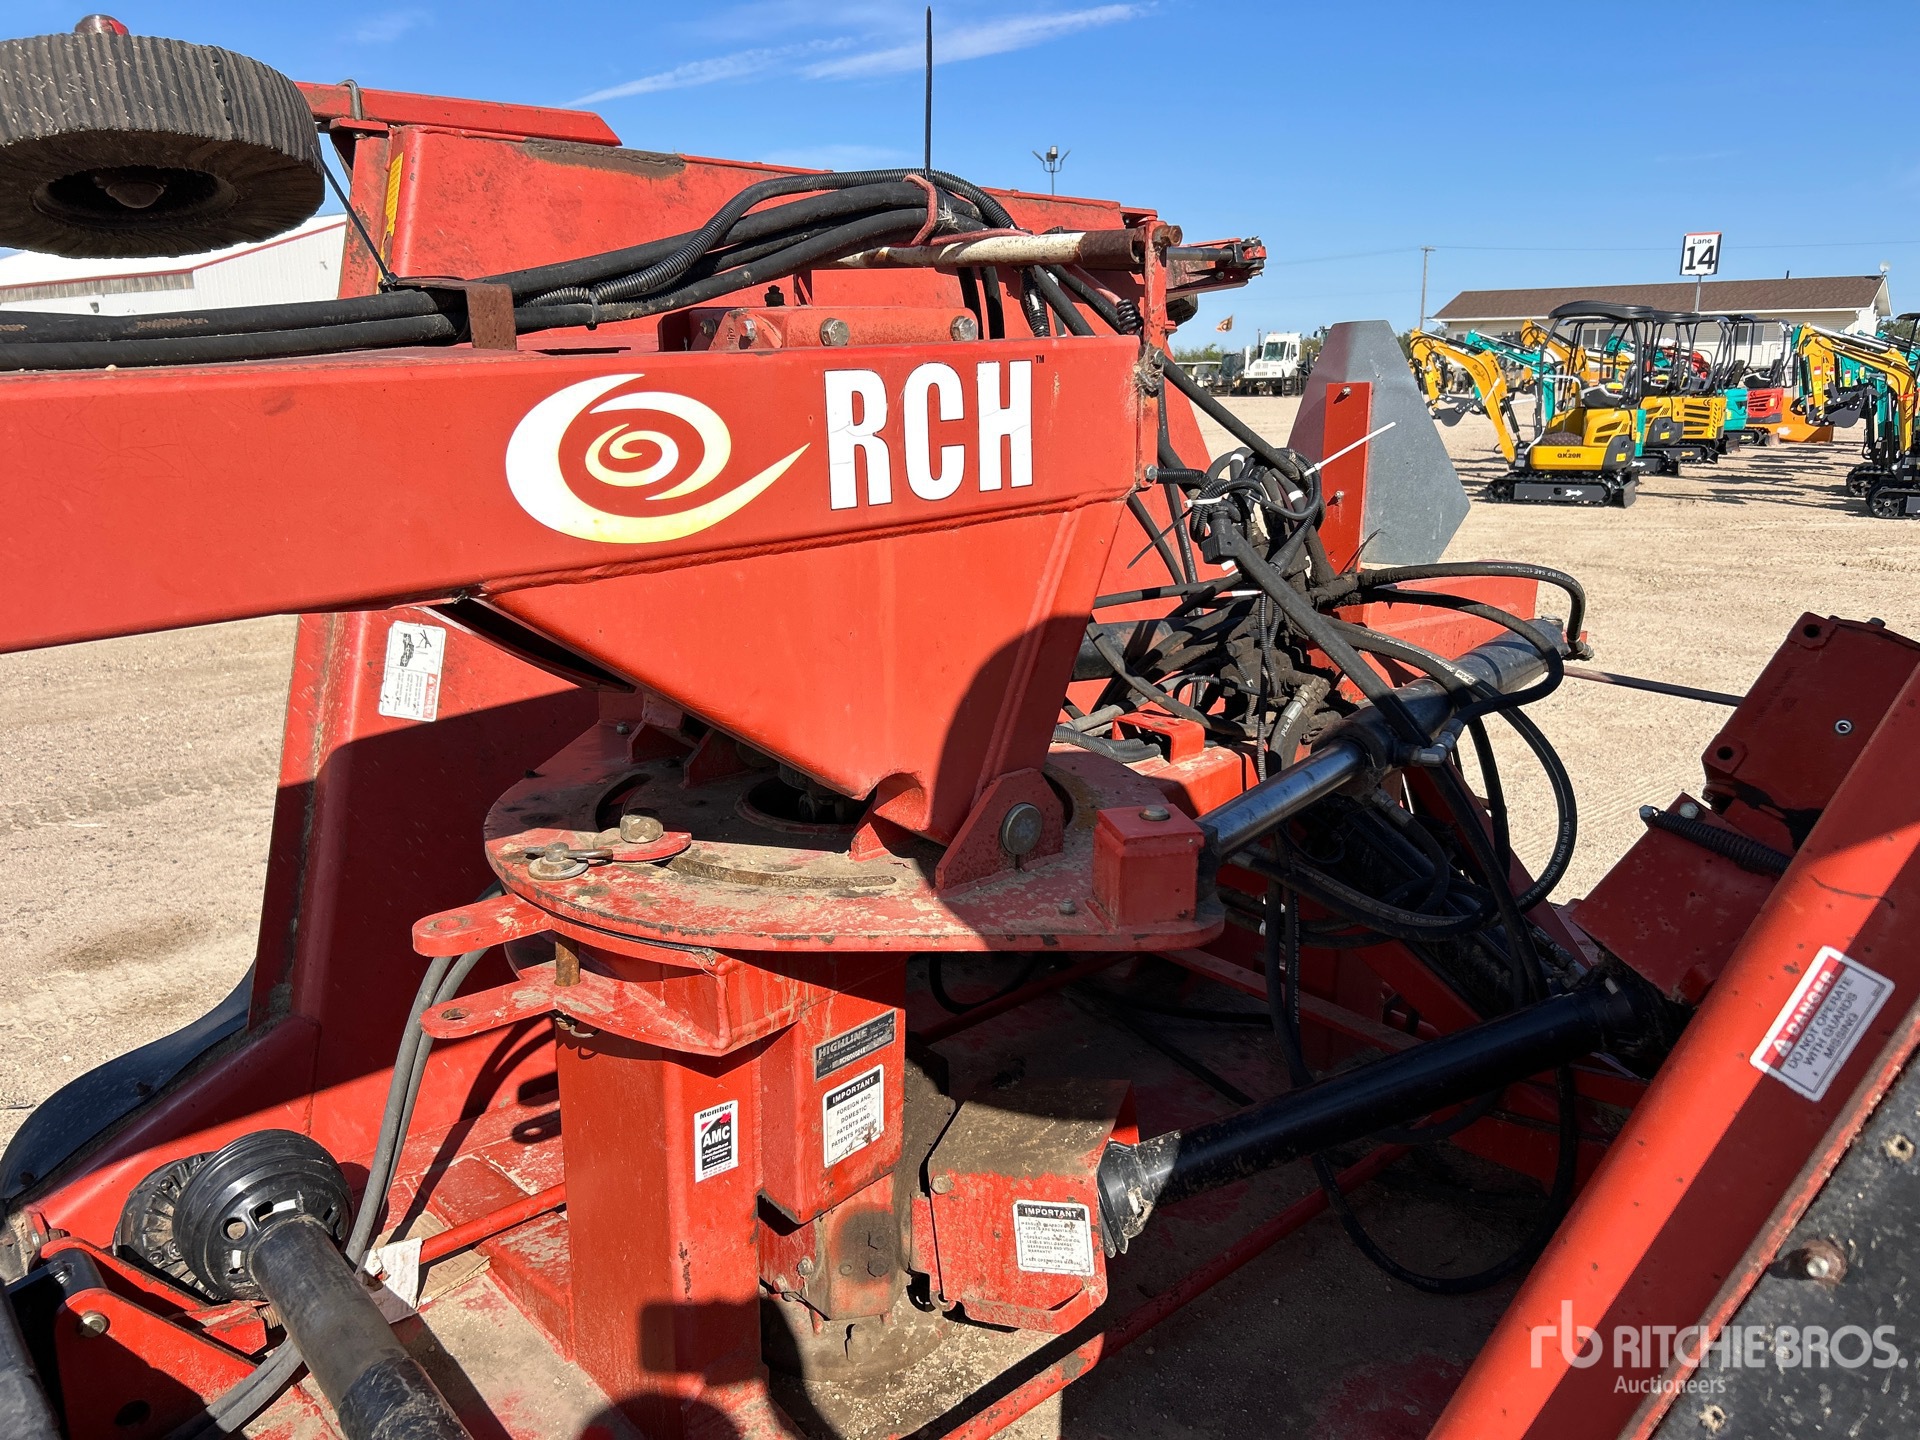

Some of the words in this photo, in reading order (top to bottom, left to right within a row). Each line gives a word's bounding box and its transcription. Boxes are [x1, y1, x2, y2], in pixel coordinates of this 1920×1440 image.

[1685, 245, 1715, 270] 14
[824, 360, 1034, 511] RCH
[1556, 844, 1567, 863] MADE
[1786, 970, 1835, 1036] DANGER
[1787, 1050, 1803, 1069] DO
[1800, 1028, 1819, 1050] NOT
[1817, 977, 1854, 1026] OPERATE
[1804, 1039, 1827, 1066] WITH
[1822, 992, 1858, 1038] GUARDS
[1824, 1012, 1859, 1059] MISSING
[818, 1027, 868, 1058] HIGHLINE
[832, 1076, 875, 1104] IMPORTANT
[700, 1103, 733, 1120] Member
[836, 1100, 860, 1116] FOREIGN
[860, 1093, 872, 1105] AND
[840, 1105, 868, 1124] DOMESTIC
[703, 1125, 731, 1148] AMC
[831, 1132, 854, 1148] PATENTS
[855, 1118, 877, 1134] PENDING
[836, 1119, 859, 1135] PATENTS
[859, 1112, 871, 1124] AND
[1024, 1207, 1077, 1218] IMPORTANT
